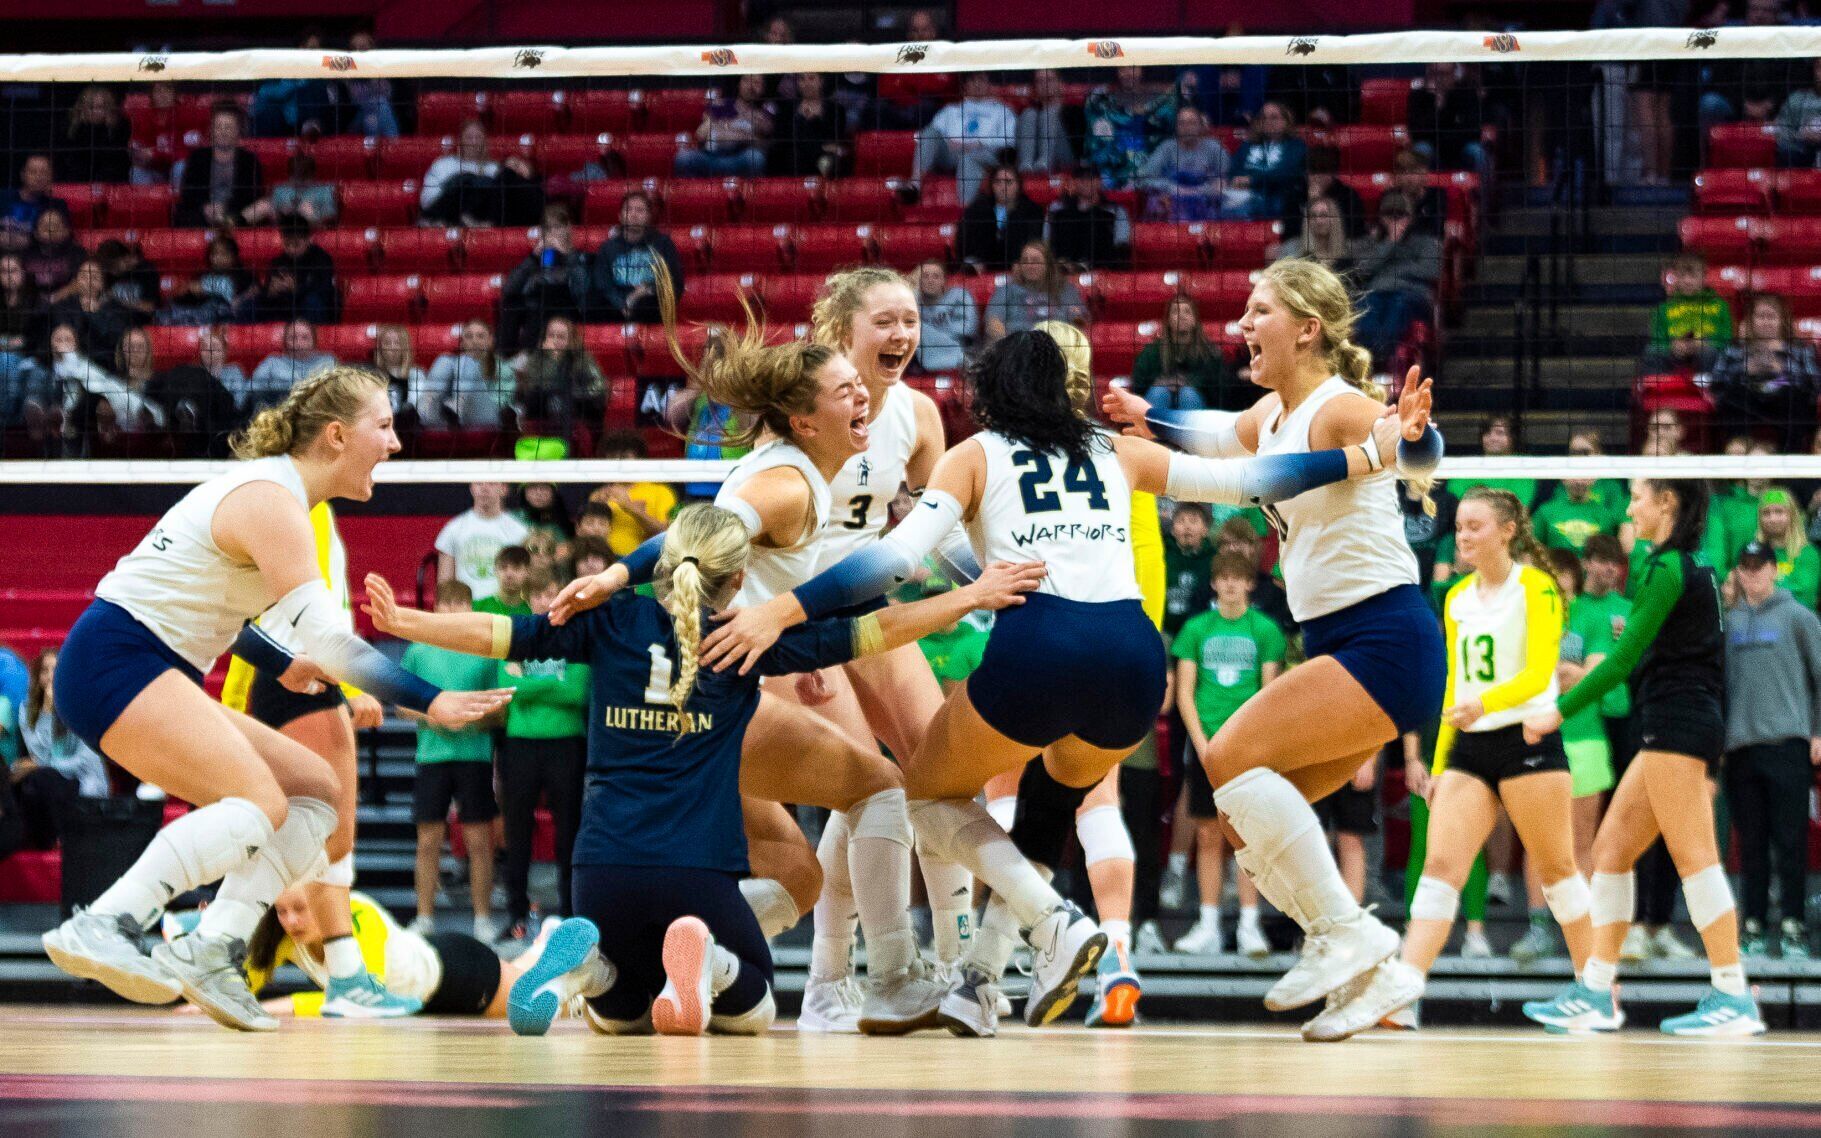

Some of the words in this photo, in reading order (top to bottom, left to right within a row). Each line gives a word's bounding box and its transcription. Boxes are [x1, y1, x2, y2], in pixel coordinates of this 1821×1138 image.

[1012, 448, 1110, 514] 24
[843, 494, 873, 530] 3
[1011, 522, 1126, 547] WARRIORS
[644, 643, 674, 705] 1
[1462, 634, 1495, 683] 13
